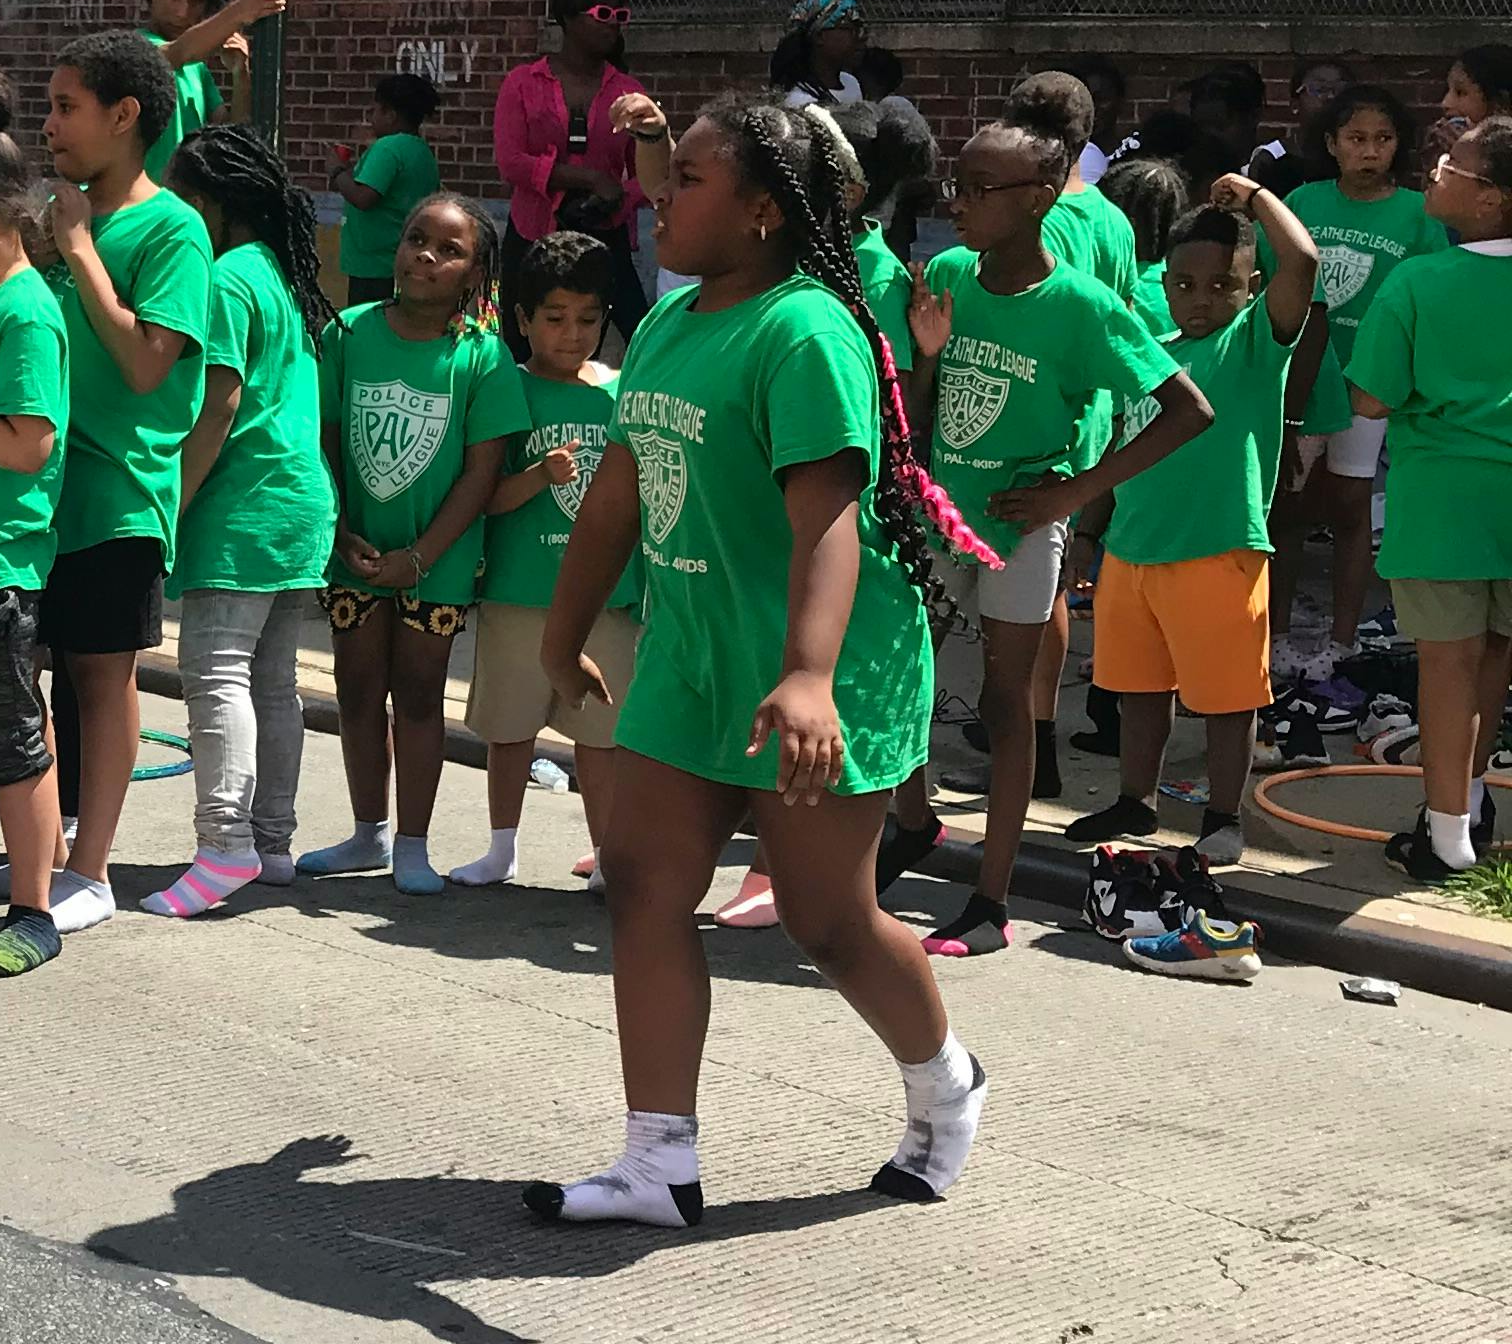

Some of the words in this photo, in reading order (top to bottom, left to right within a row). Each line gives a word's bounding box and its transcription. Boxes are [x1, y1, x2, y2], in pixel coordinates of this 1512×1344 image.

[395, 40, 479, 84] ONLY
[1320, 226, 1370, 246] ATHLETIC
[1368, 234, 1408, 259] LEAGUE
[1321, 261, 1351, 288] PAL
[951, 335, 1001, 369] ATHLETIC
[1000, 347, 1038, 384] LEAGUE
[359, 388, 435, 413] POLICE
[946, 374, 995, 395] POLICE
[949, 388, 980, 424] PAL
[351, 411, 381, 488] ATHLETIC
[366, 411, 416, 461] PAL
[525, 423, 560, 459] POLICE
[560, 422, 608, 448] ATHLETIC
[389, 426, 440, 488] LEAGUE
